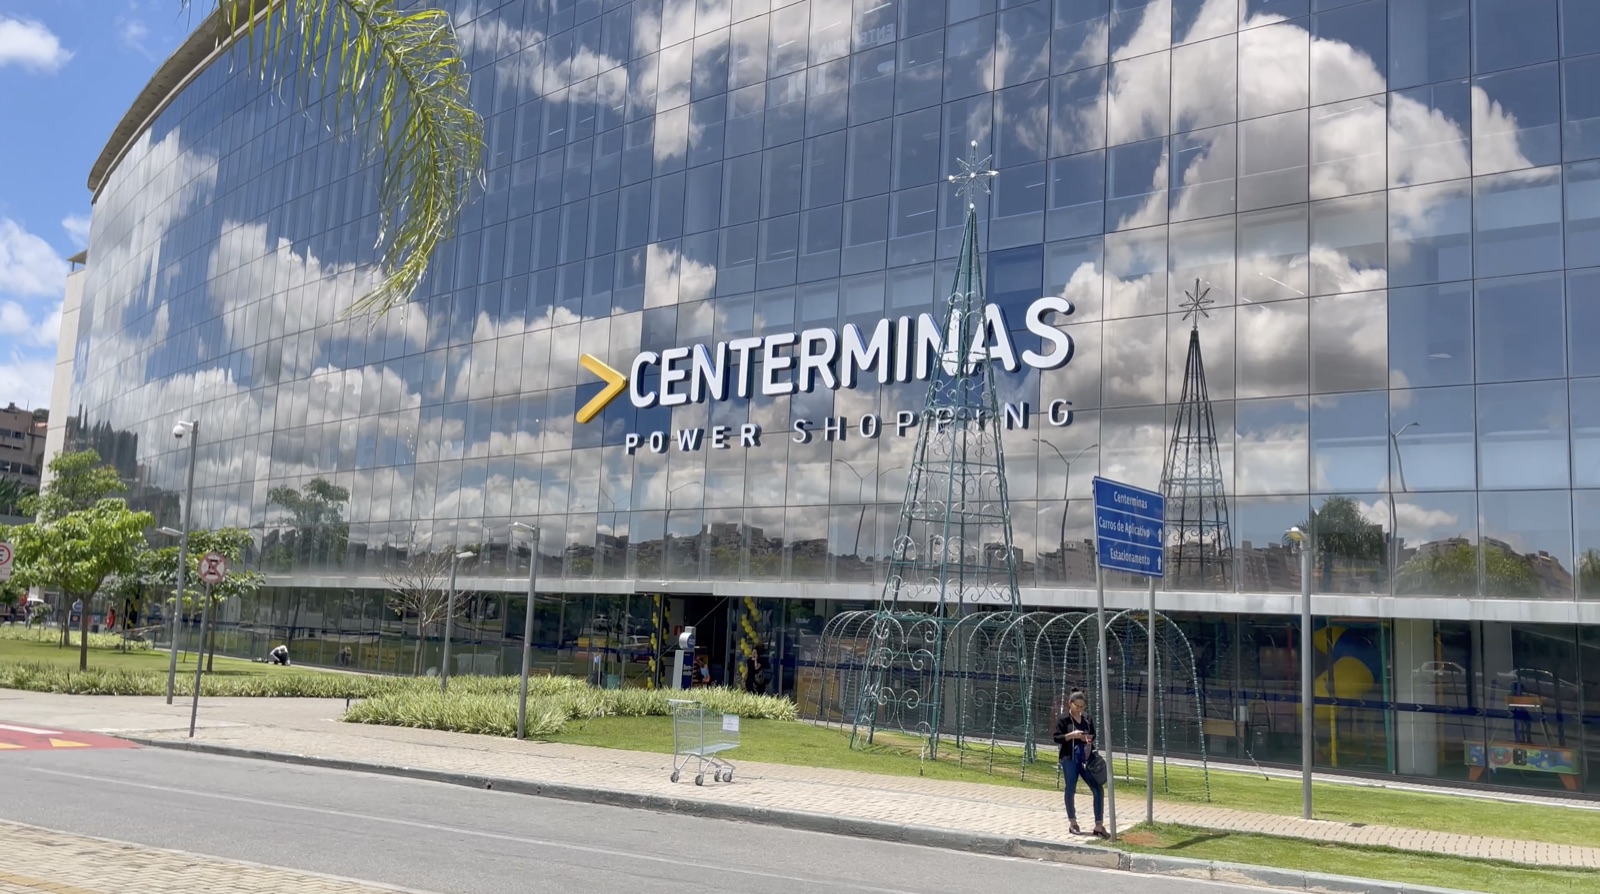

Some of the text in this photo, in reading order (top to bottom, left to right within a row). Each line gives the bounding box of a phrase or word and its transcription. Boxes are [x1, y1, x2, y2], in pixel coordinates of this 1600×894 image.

[629, 296, 1075, 408] CENTERMINAS
[625, 399, 1073, 455] POWER SHOPPING
[1113, 490, 1148, 509] Centerminas
[1098, 516, 1151, 538] Carros de Aplicativo
[1110, 547, 1151, 566] Estacionamento
